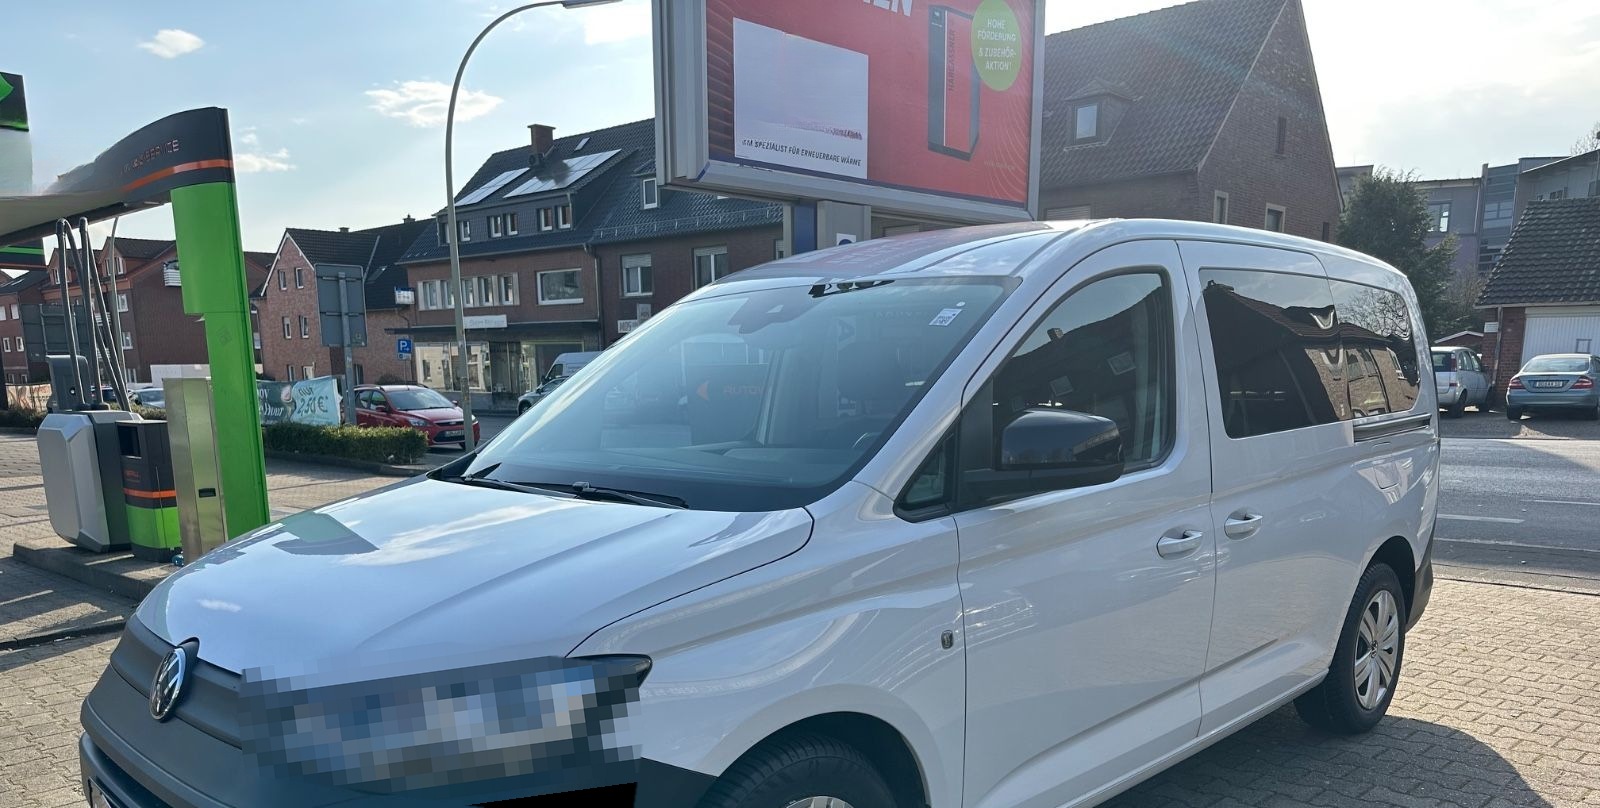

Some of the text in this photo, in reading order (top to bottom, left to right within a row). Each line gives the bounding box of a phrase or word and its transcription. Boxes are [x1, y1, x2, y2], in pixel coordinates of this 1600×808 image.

[987, 18, 1006, 29] HOHE
[754, 140, 788, 154] SPEZIALIST
[788, 145, 800, 155] FÜR
[801, 149, 840, 163] ERNEUERBARE
[840, 157, 862, 167] WÄRME
